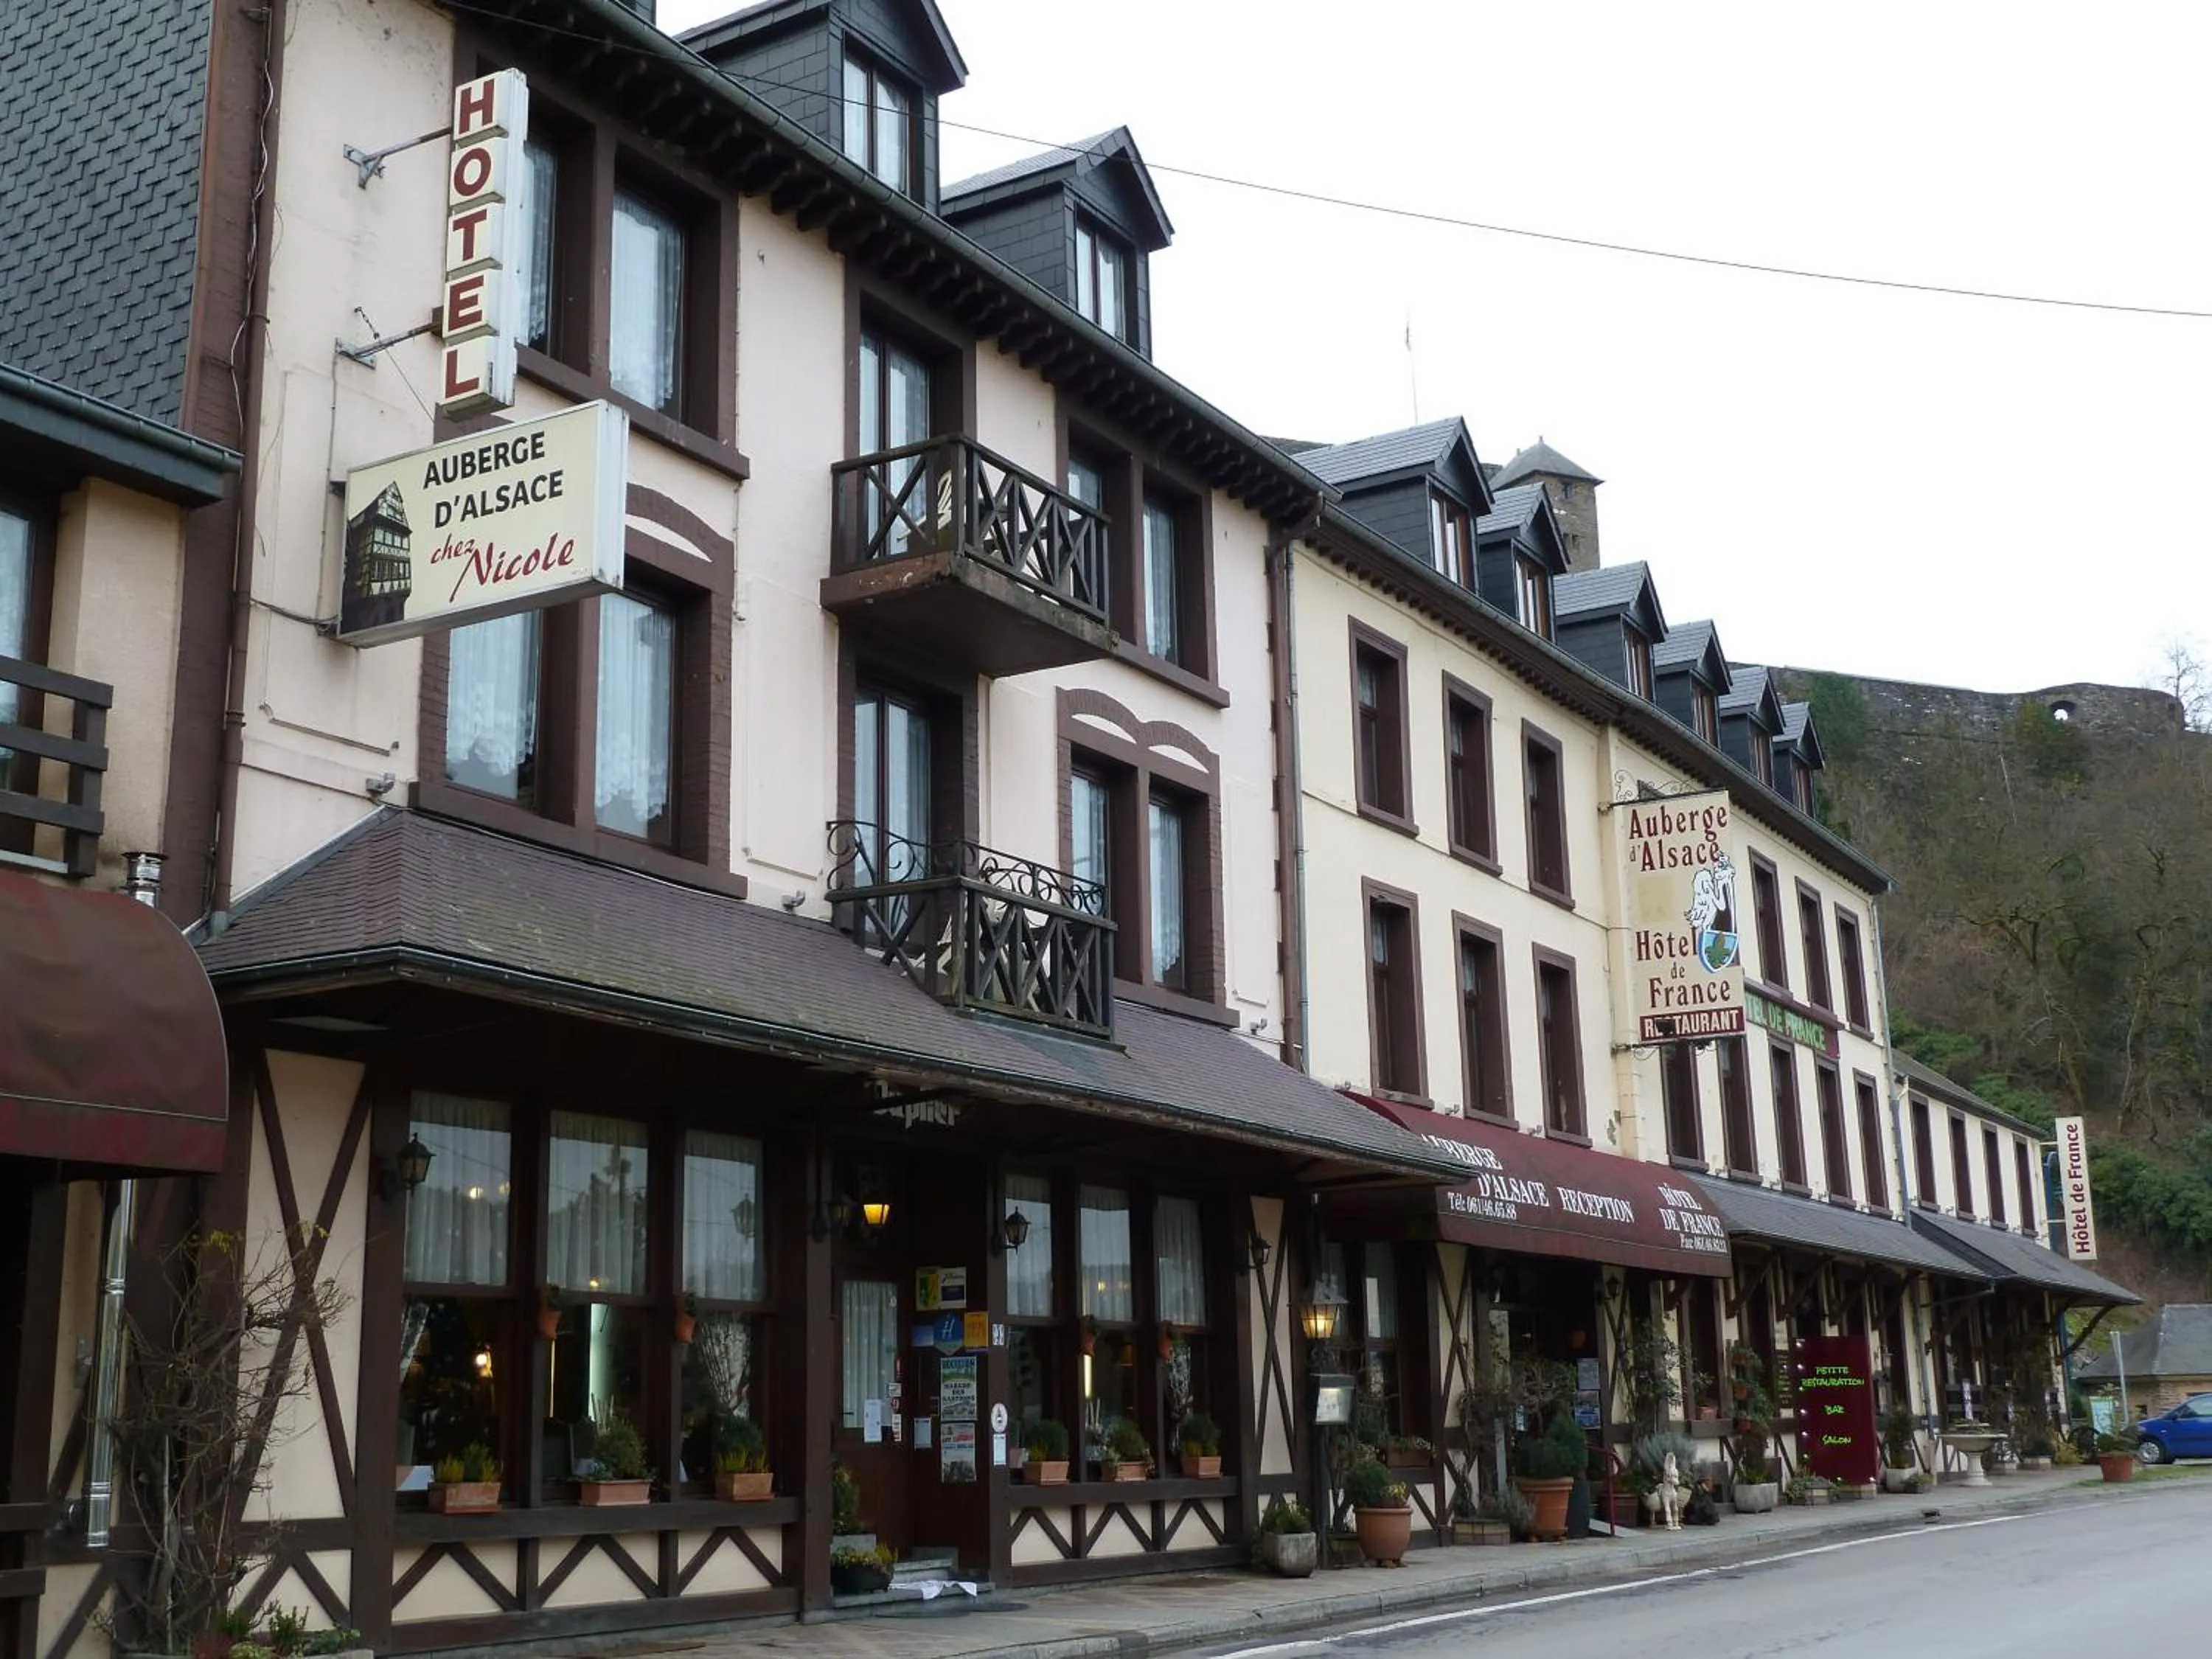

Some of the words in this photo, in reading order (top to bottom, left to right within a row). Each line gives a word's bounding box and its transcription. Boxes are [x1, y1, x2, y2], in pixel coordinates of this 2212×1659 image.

[445, 78, 495, 400] HOTEL
[422, 431, 546, 490] AUBERGE
[434, 470, 563, 529] D'ALSACE
[431, 532, 476, 565] chez
[450, 536, 575, 603] Nicole
[1629, 804, 1728, 843] Auberge
[1630, 839, 1719, 872] d'Alsace
[1636, 927, 1698, 961] Hôtel
[1671, 961, 1685, 980] de
[1649, 978, 1731, 1009] France
[1644, 1009, 1739, 1038] RETAURANT
[1769, 1001, 1784, 1033] DE
[1784, 1009, 1826, 1051] FRANCE
[2067, 1123, 2082, 1179] France
[1478, 1172, 1550, 1207] D'ALSACE
[1557, 1186, 1635, 1223] RECEPTION
[2070, 1183, 2085, 1203] de
[1659, 1208, 1680, 1231] DE
[1680, 1211, 1724, 1237] FRANCE
[2071, 1208, 2090, 1253] Hôtel
